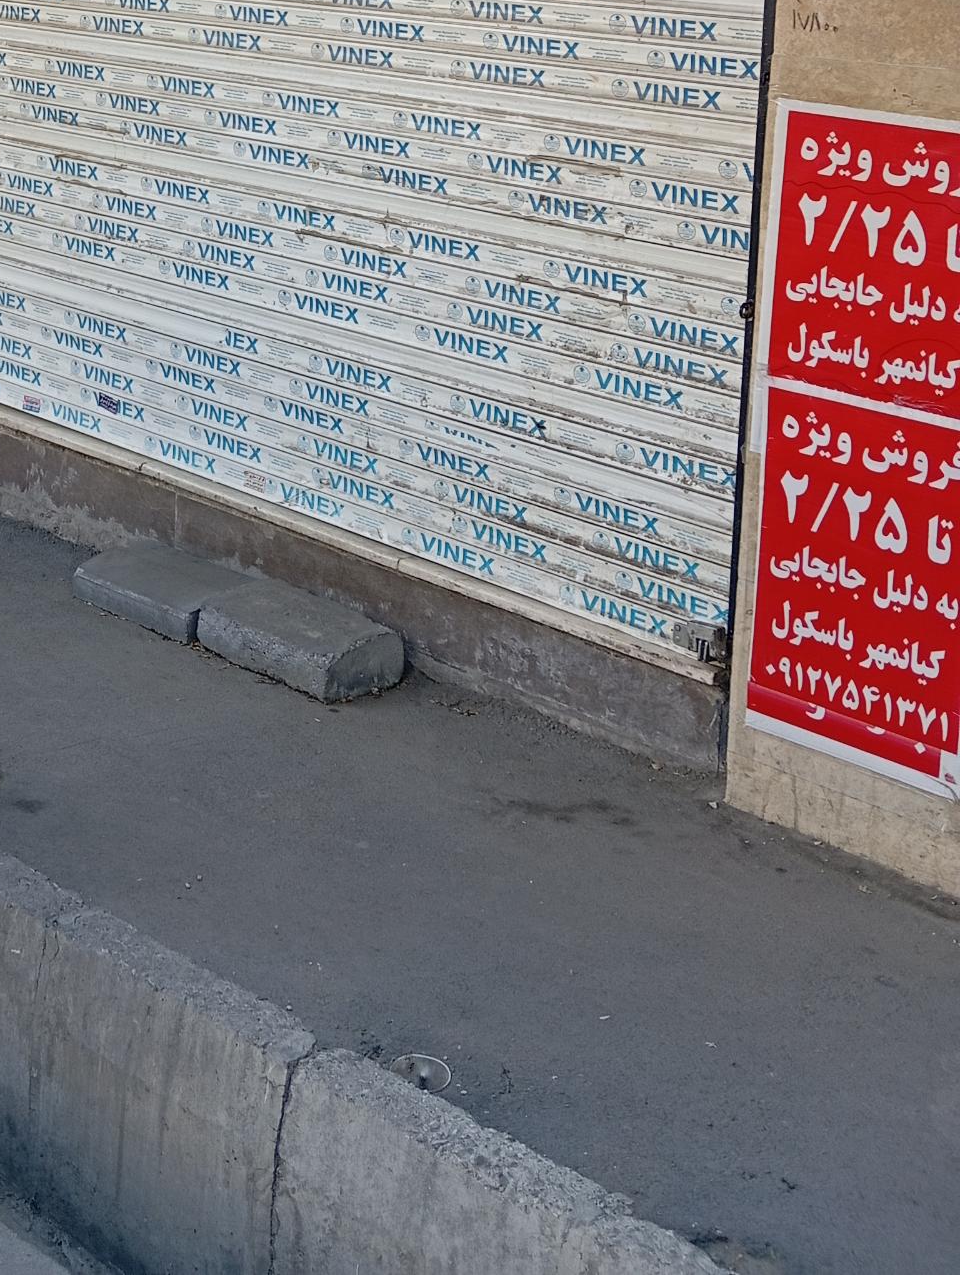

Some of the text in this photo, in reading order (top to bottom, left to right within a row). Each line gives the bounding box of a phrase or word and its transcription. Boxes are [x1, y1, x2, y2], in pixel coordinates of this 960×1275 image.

[92, 15, 143, 36] VINEX
[327, 44, 393, 69] VINEX
[632, 80, 720, 111] VINEX
[356, 18, 424, 43] VINEX
[668, 51, 759, 81] VINEX
[629, 14, 717, 42] VINEX
[108, 93, 160, 116] VINEX
[343, 131, 410, 159] VINEX
[650, 181, 740, 216] VINEX
[160, 75, 215, 99] VINEX
[277, 93, 339, 118] VINEX
[563, 136, 646, 167] VINEX
[800, 131, 873, 182] ویژه
[133, 122, 186, 147] VINEX
[248, 143, 309, 170] VINEX
[527, 193, 607, 225] VINEX
[87, 216, 138, 243] VINEX
[197, 241, 254, 271] VINEX
[466, 305, 542, 341] VINEX
[104, 194, 156, 221] VINEX
[339, 247, 406, 278] VINEX
[648, 316, 738, 356] VINEX
[154, 178, 209, 205] VINEX
[273, 203, 335, 232] VINEX
[563, 263, 646, 299] VINEX
[173, 262, 228, 291] VINEX
[294, 292, 358, 325] VINEX
[595, 369, 680, 409] VINEX
[785, 265, 946, 326] دلیل جابجایی
[184, 345, 241, 377] VINEX
[304, 381, 369, 417] VINEX
[787, 322, 870, 379] باسکول
[82, 363, 133, 394] VINEX
[312, 438, 377, 475] VINEX
[325, 358, 391, 393] VINEX
[468, 398, 544, 437] VINEX
[782, 411, 852, 465] ویژه
[160, 362, 215, 394] VINEX
[280, 399, 342, 435] VINEX
[575, 492, 658, 537] VINEX
[159, 439, 214, 474] VINEX
[281, 482, 343, 521] VINEX
[581, 590, 665, 639] VINEX
[328, 471, 393, 510] VINEX
[471, 520, 547, 563] VINEX
[927, 514, 954, 565] تا
[770, 545, 959, 631] به دلیل جابجایی
[771, 600, 854, 661] باسکول
[765, 656, 949, 742] ۰۹۱۲۷۵۴۱۳۷۱
